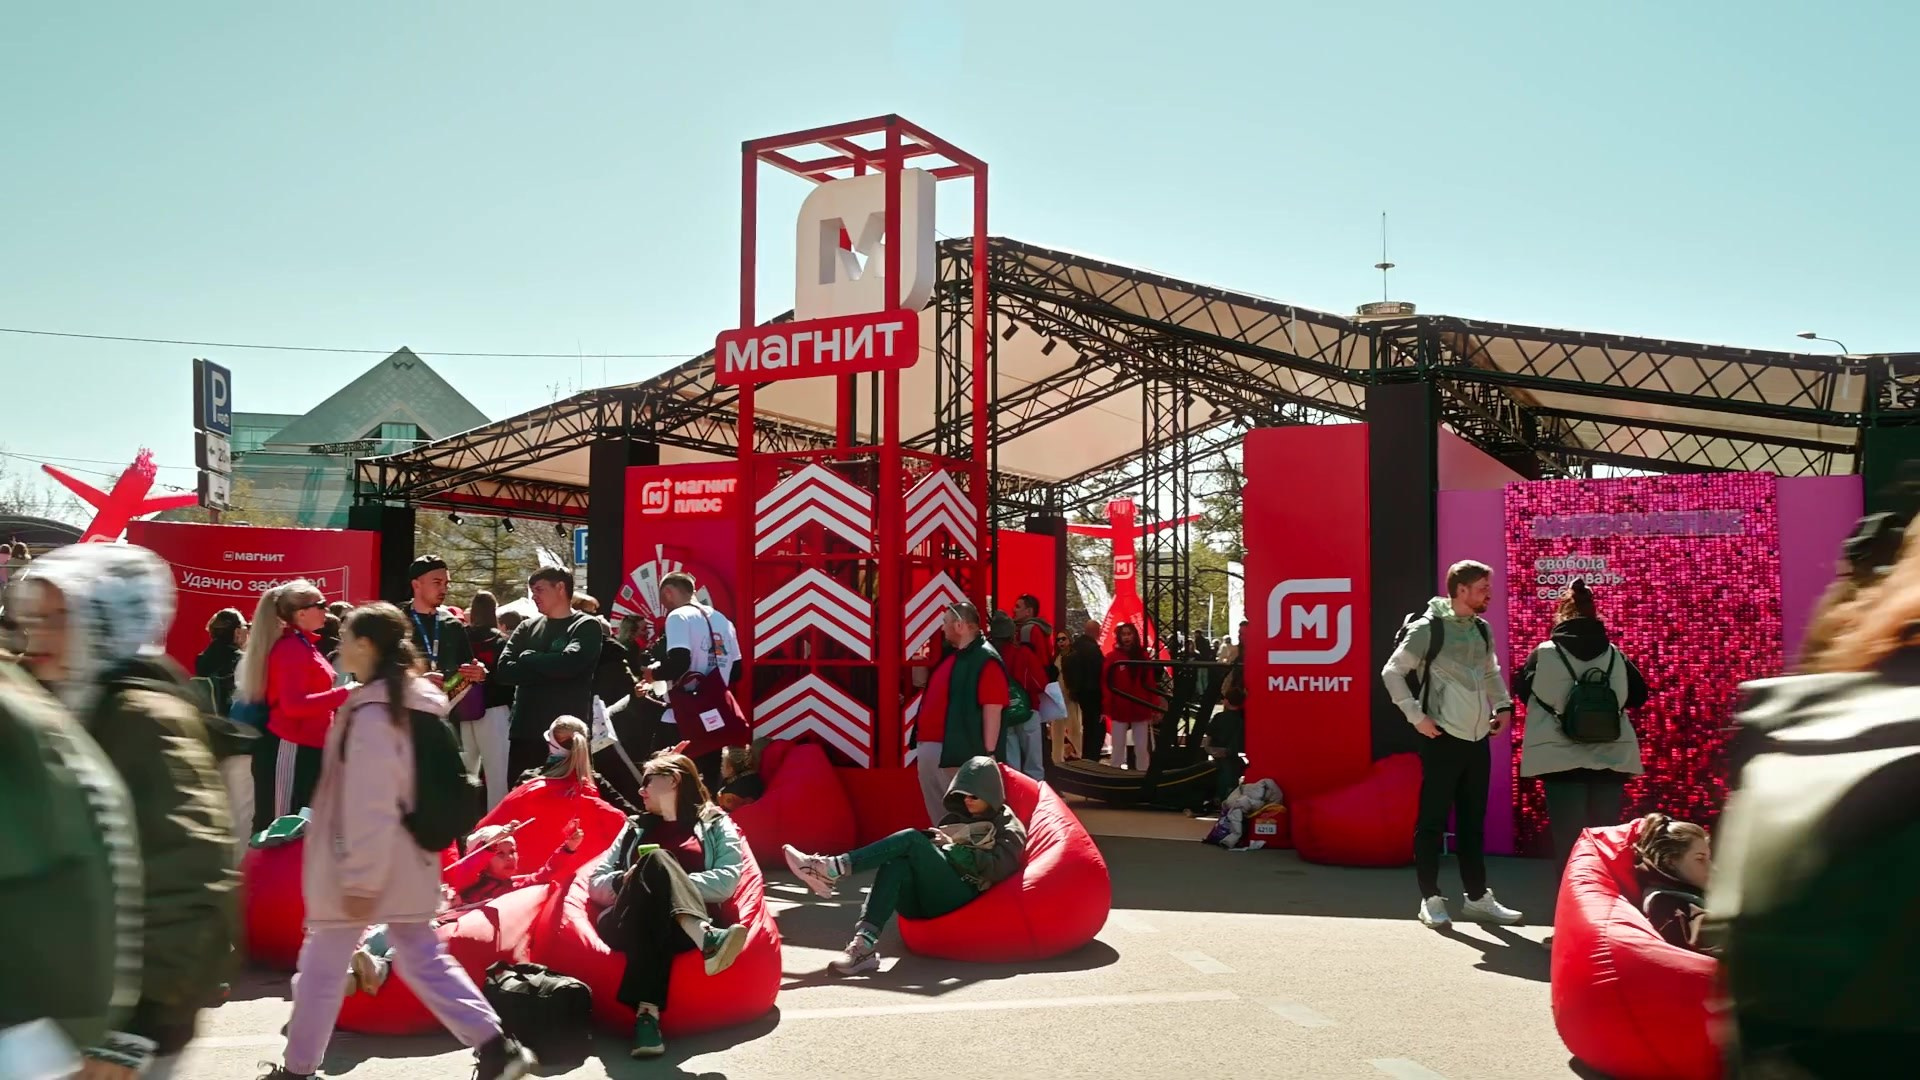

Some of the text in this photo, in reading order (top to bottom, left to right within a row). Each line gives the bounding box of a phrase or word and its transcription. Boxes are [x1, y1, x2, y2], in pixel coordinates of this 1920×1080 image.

[724, 321, 904, 373] магнит
[211, 369, 228, 424] P
[674, 478, 738, 495] магнит
[234, 552, 285, 562] магнит
[1537, 554, 1605, 571] свобода
[181, 571, 243, 591] Удачно
[1268, 675, 1353, 692] МАГНИТ
